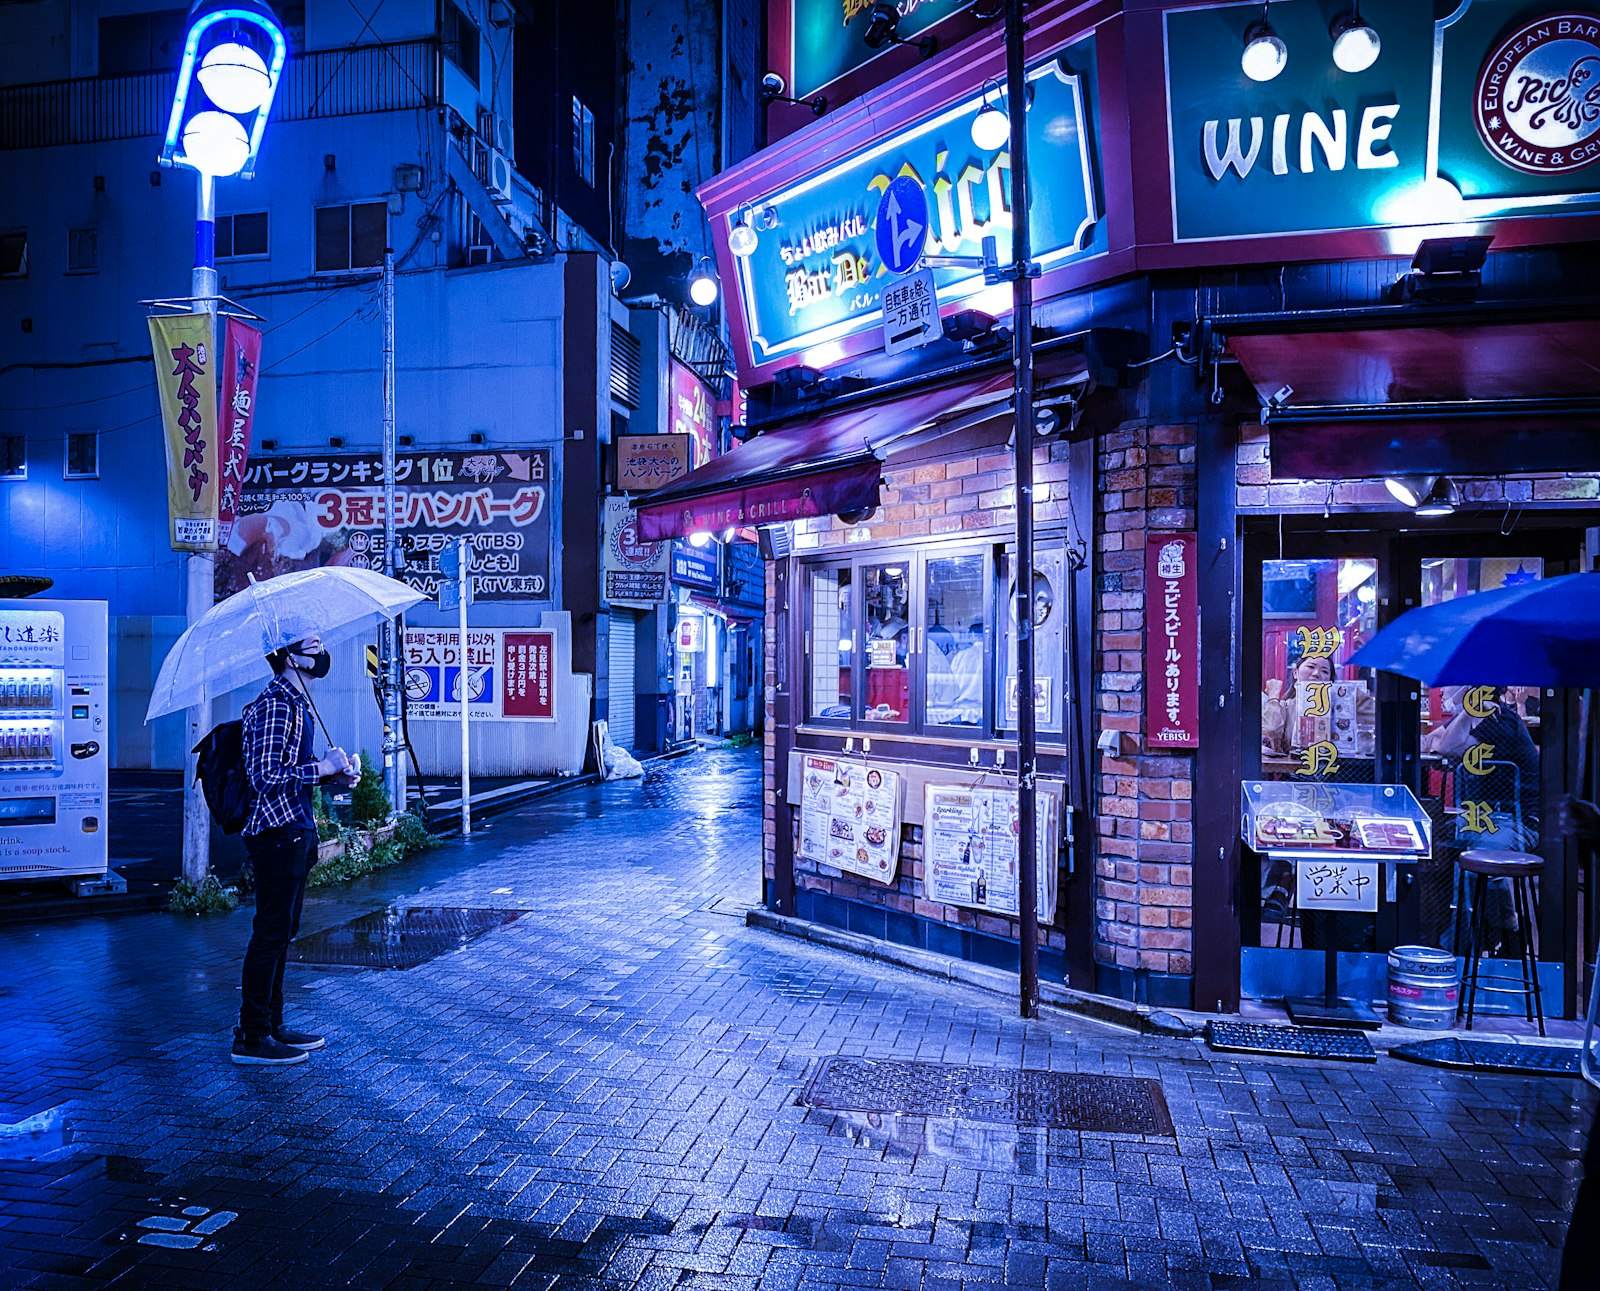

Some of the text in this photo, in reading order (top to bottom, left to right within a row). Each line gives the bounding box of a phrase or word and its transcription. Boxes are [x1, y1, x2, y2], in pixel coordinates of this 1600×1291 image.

[1485, 21, 1599, 111] EUROPEAN BAR
[1203, 104, 1400, 181] WINE
[1500, 132, 1546, 165] WINE
[1551, 153, 1565, 165] &
[780, 215, 867, 265] ちょい飲みバル
[785, 252, 869, 316] Bar De
[885, 279, 930, 311] 自転車を除く
[887, 299, 931, 327] 一方通行
[171, 342, 208, 502] 大人のハンバーグ
[532, 454, 544, 480] 入口
[624, 466, 682, 478] ハンバーグ
[703, 500, 787, 525] WINE & GRILL
[0, 625, 59, 643] し道楽
[404, 648, 495, 665] ち入り禁止!
[1165, 581, 1181, 726] ヱビスビールあります。
[1157, 733, 1190, 741] YEBISU
[22, 847, 43, 859] soup
[45, 845, 70, 854] stock.
[1305, 866, 1371, 900] 営業中
